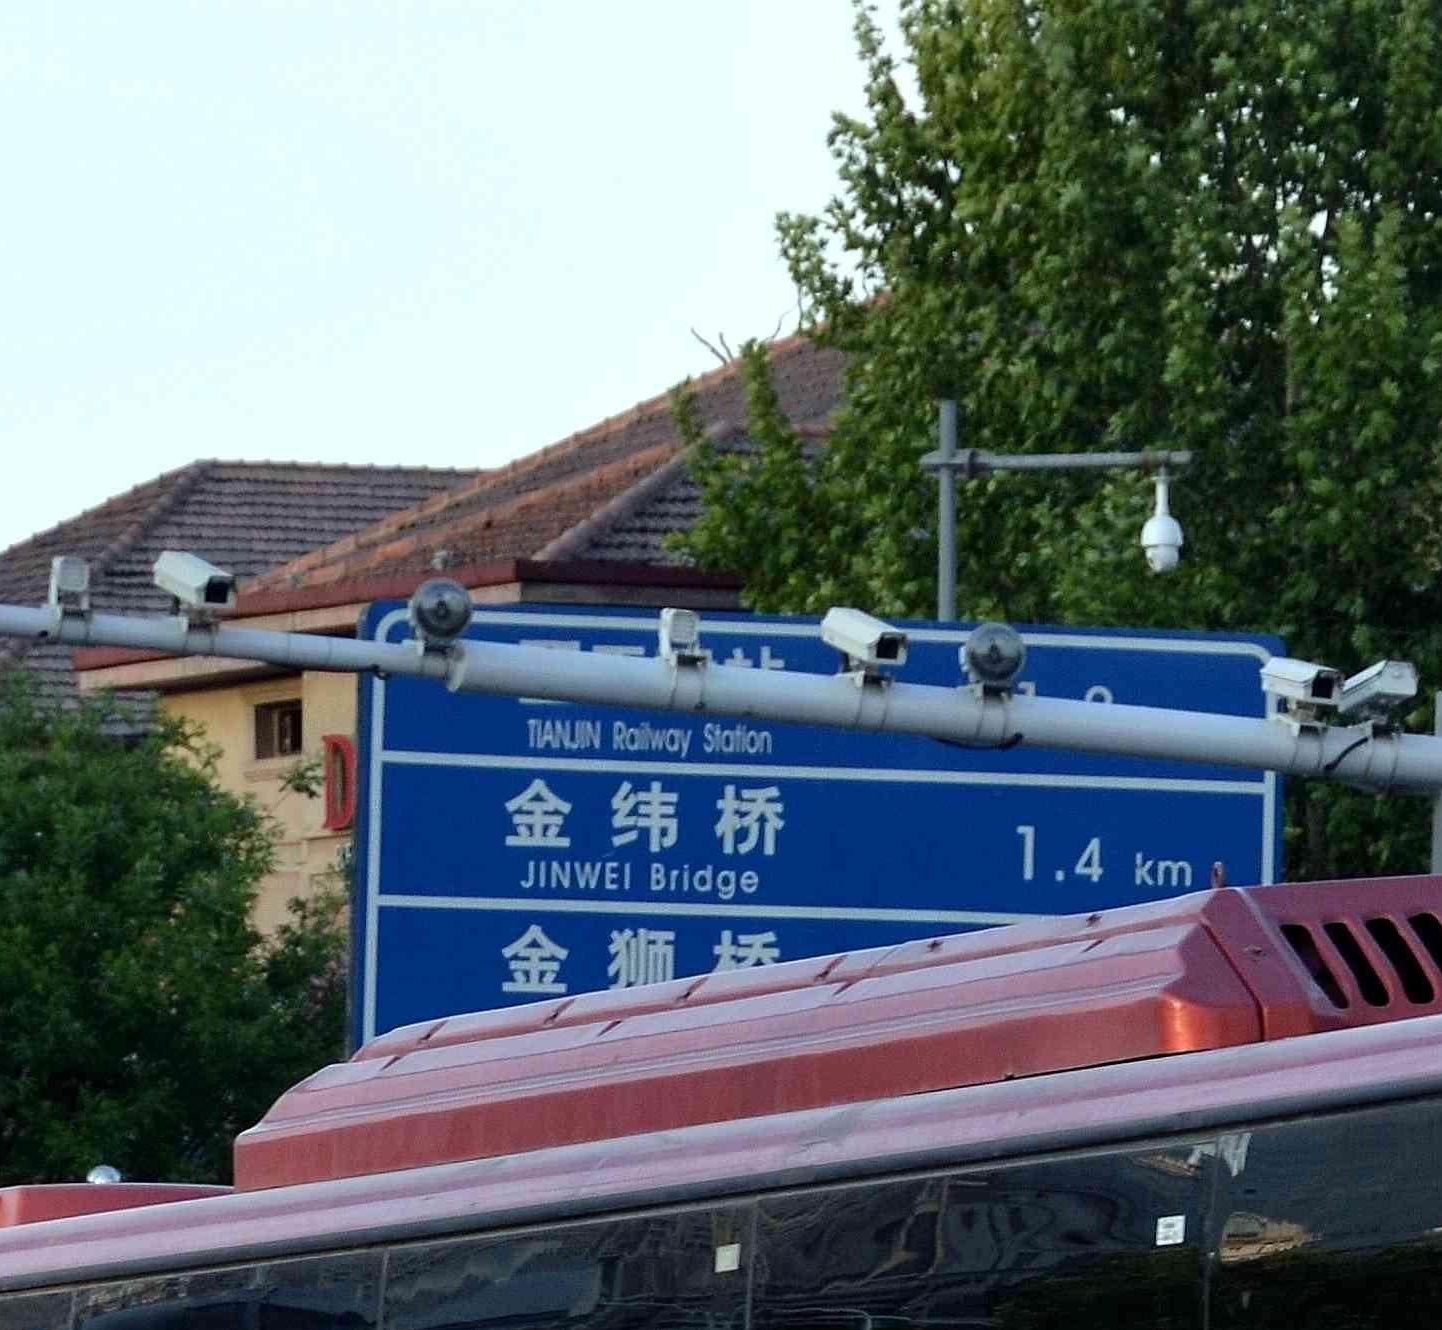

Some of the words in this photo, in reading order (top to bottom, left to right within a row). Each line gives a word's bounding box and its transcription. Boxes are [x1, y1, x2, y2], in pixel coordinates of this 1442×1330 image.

[526, 717, 601, 750] TIANJIN
[611, 720, 693, 760] Railway
[702, 721, 774, 755] Station
[503, 777, 786, 857] 金纬桥
[520, 860, 632, 891] JINWEI
[649, 862, 760, 900] Bridge
[1015, 825, 1104, 884] 1.4
[1133, 851, 1193, 888] km
